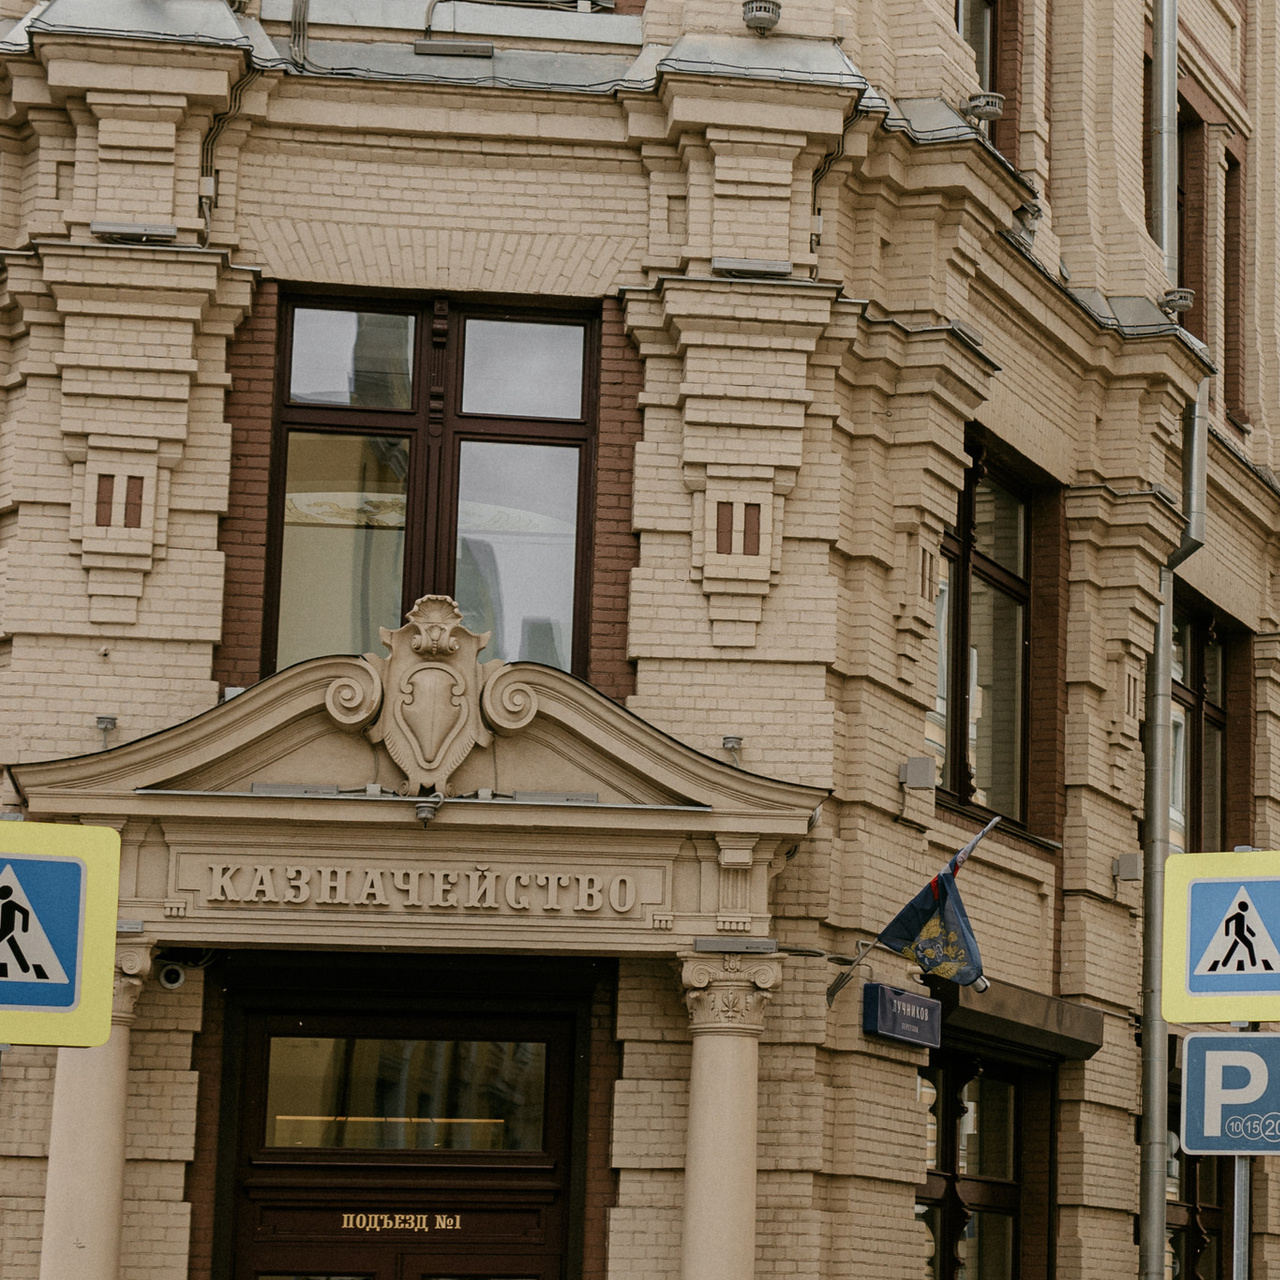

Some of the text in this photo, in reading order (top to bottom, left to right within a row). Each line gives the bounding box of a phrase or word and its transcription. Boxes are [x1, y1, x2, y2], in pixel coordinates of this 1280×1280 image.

[206, 863, 637, 913] КАЗНАЧЕЙСТВО
[892, 999, 929, 1021] ЛУЧНИКОВ
[1203, 1051, 1269, 1137] P
[1229, 1121, 1242, 1133] 10
[1246, 1120, 1260, 1134] 15
[341, 1213, 461, 1232] ПОДЪЕЗД №1
